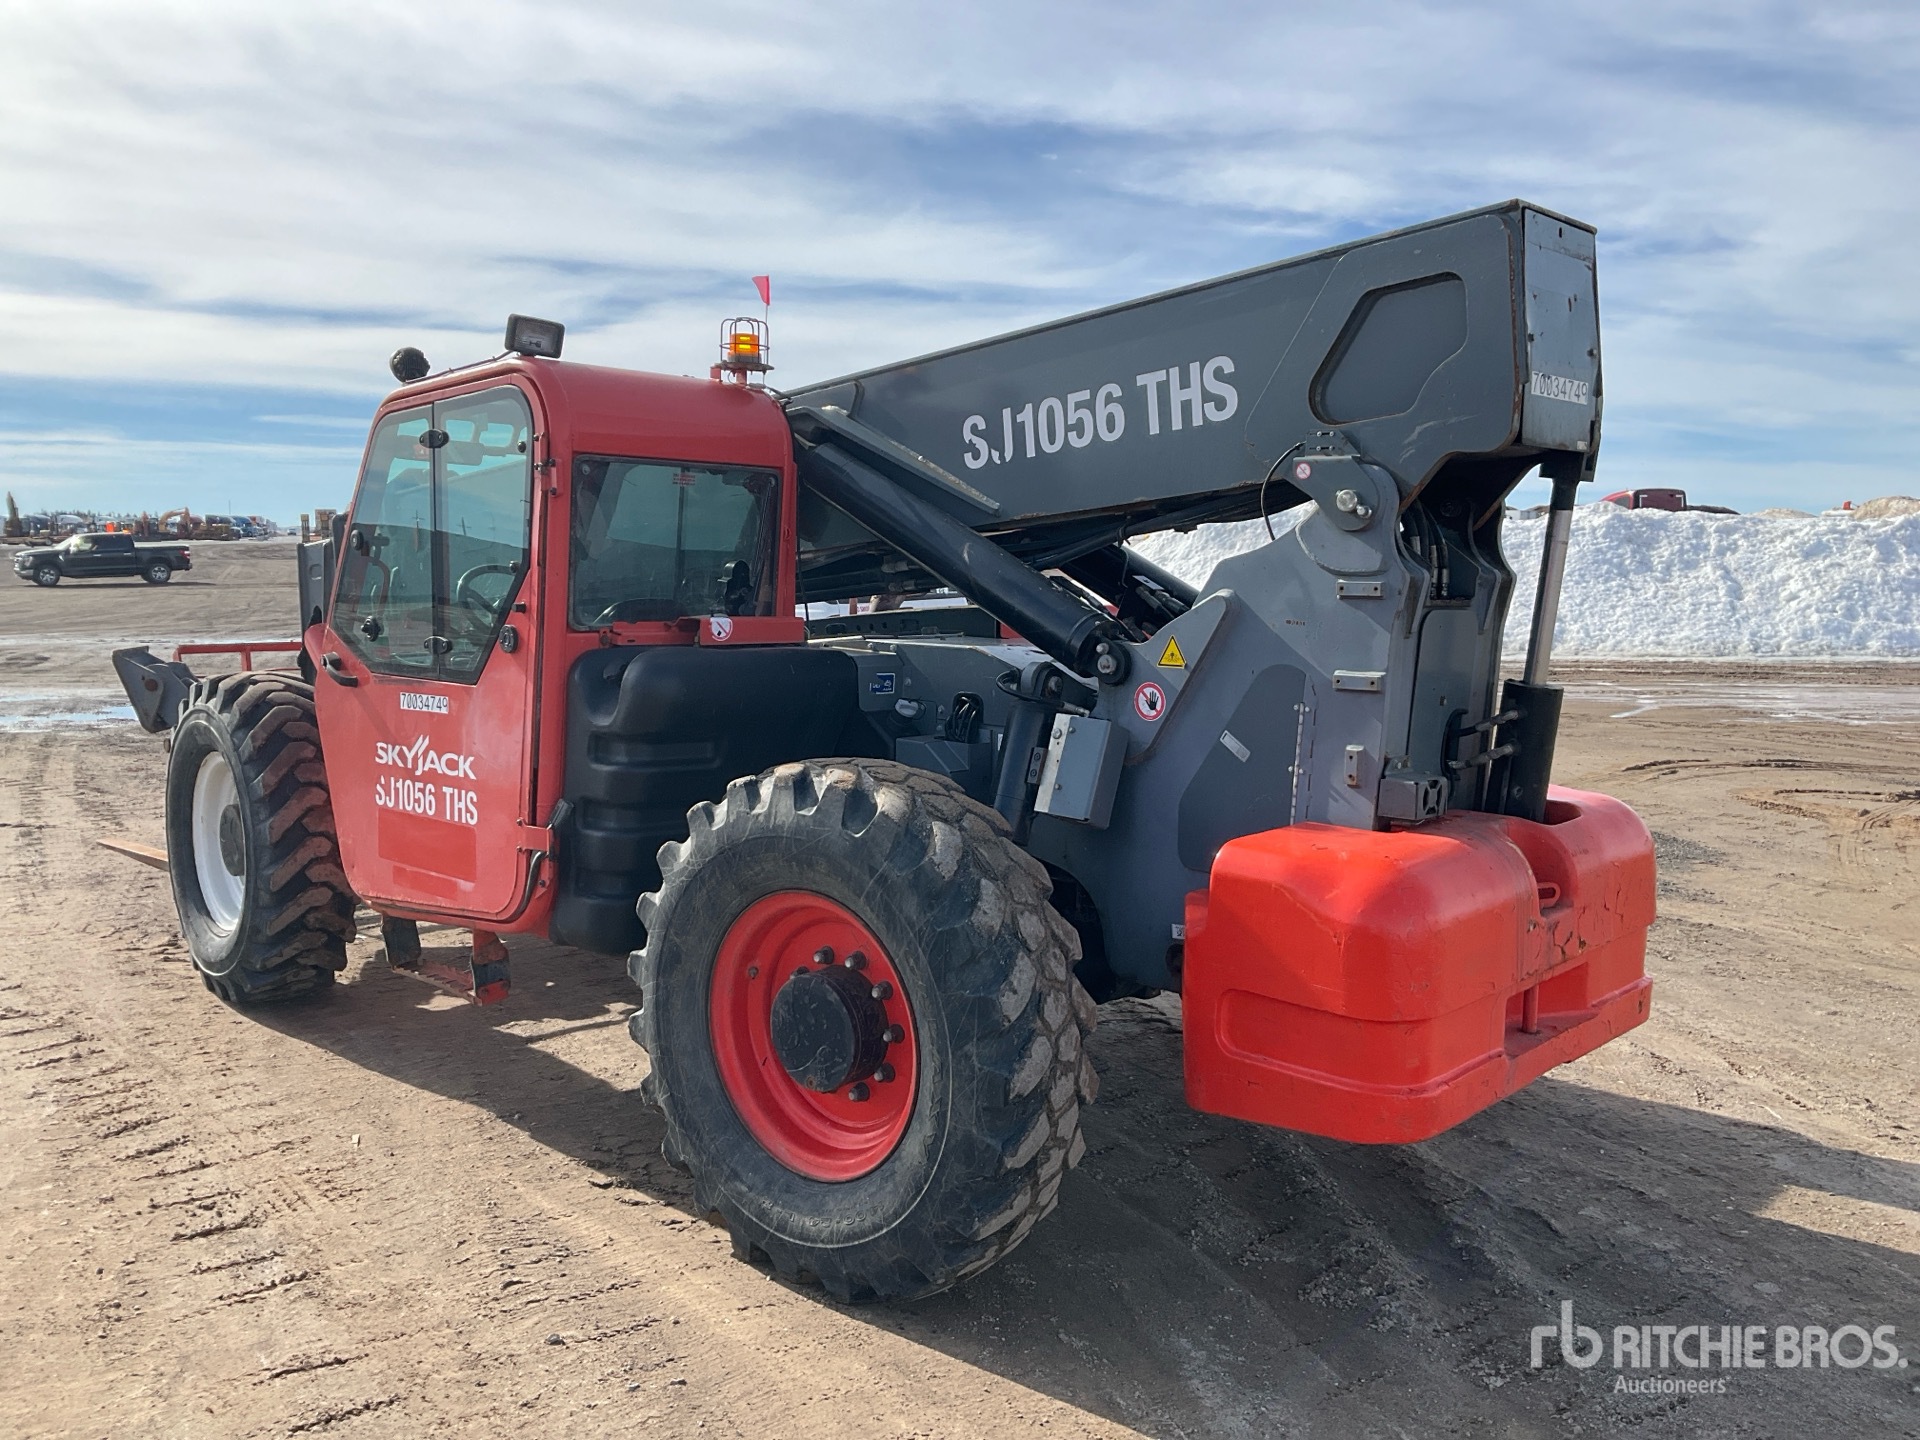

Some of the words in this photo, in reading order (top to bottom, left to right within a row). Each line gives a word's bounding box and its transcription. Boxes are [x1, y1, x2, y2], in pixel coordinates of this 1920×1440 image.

[962, 383, 1125, 469] SJ1056
[1136, 355, 1238, 435] THS
[375, 734, 477, 780] SKYJACK
[375, 775, 436, 815] SJ1056
[442, 786, 478, 825] THS
